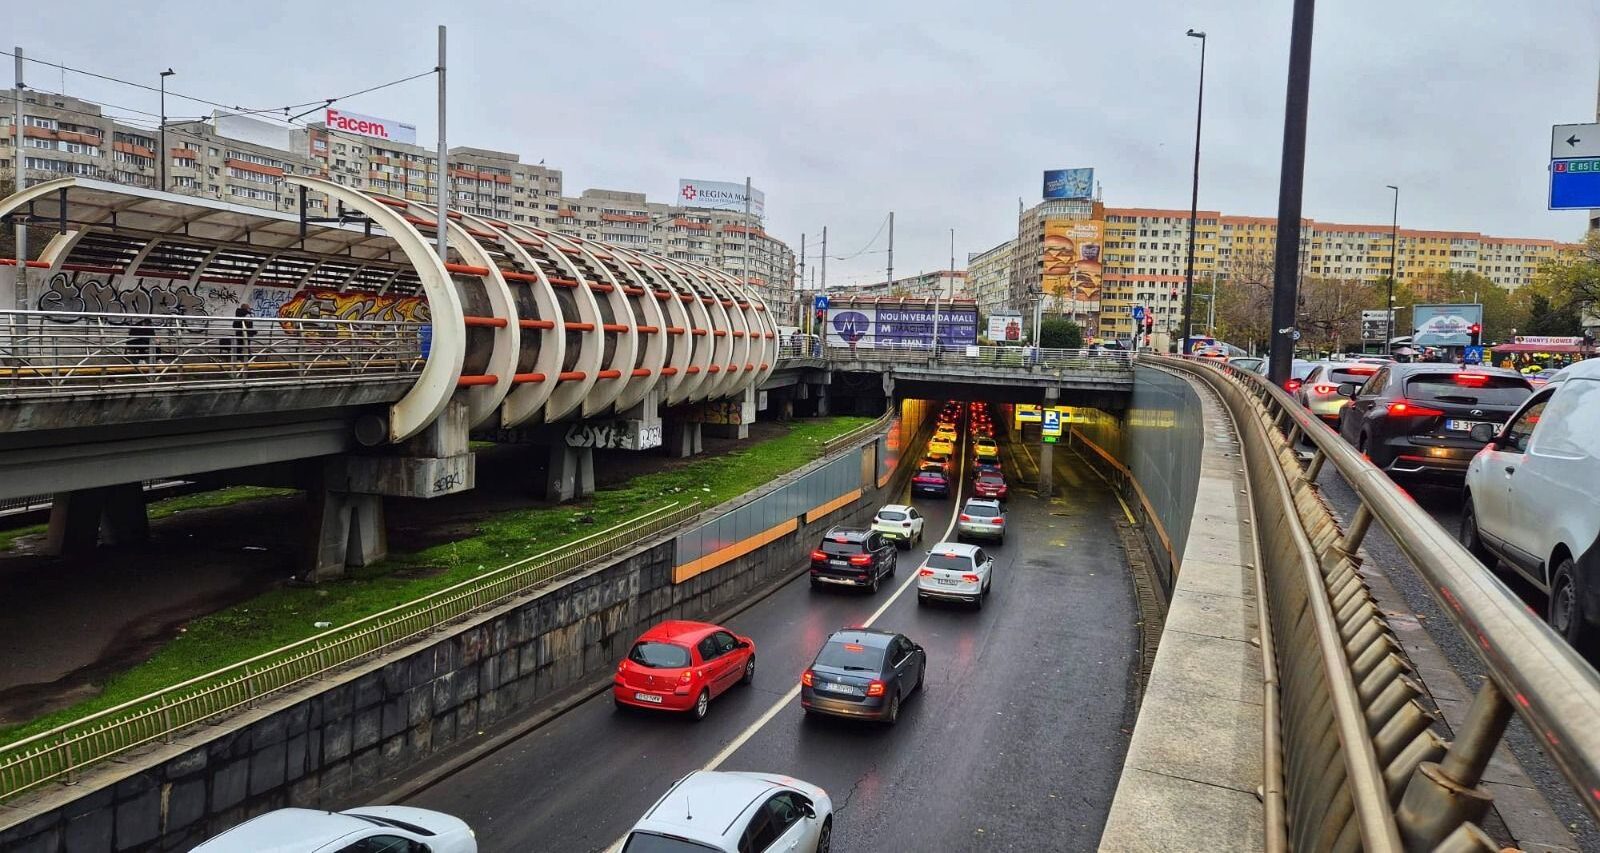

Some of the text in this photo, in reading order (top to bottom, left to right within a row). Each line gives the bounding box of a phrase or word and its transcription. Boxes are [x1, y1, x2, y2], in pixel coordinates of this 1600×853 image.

[327, 109, 388, 137] Facem.
[1570, 162, 1576, 171] E
[699, 190, 733, 199] REGINA
[880, 312, 899, 321] NOU
[951, 314, 974, 322] MALL
